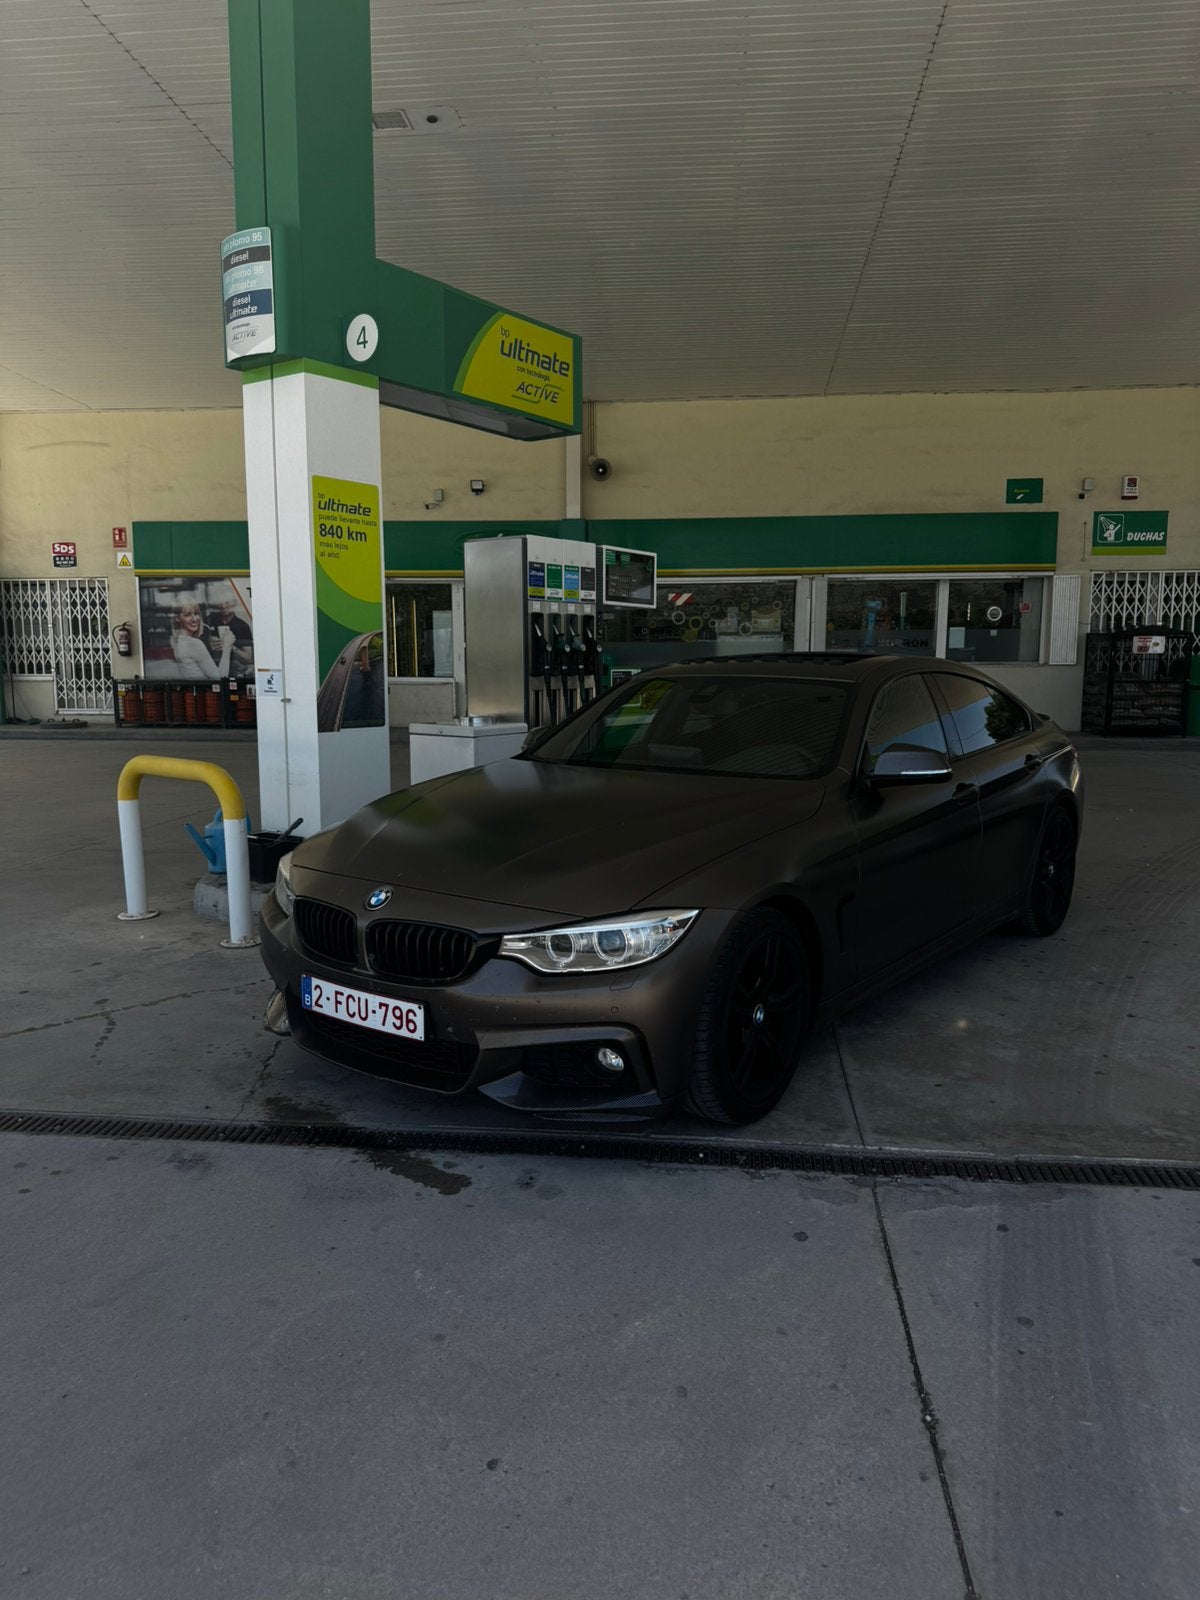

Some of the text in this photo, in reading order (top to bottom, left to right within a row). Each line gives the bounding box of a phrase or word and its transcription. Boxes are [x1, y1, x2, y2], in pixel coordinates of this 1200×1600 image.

[229, 236, 250, 248] plomo
[251, 231, 263, 242] 95
[230, 251, 249, 265] diesel
[253, 264, 264, 275] 98
[232, 296, 251, 307] diesel
[229, 305, 258, 320] ultimate
[231, 331, 257, 342] ACTIVE
[355, 325, 368, 349] 4
[500, 338, 570, 378] ultimate
[516, 381, 560, 404] ACTIVE
[318, 498, 371, 517] ultimate
[319, 523, 367, 543] 840 km
[1126, 531, 1166, 542] DUCHAS
[53, 543, 75, 554] SDS
[304, 993, 311, 1006] B
[314, 984, 418, 1033] 2-FCU-796
